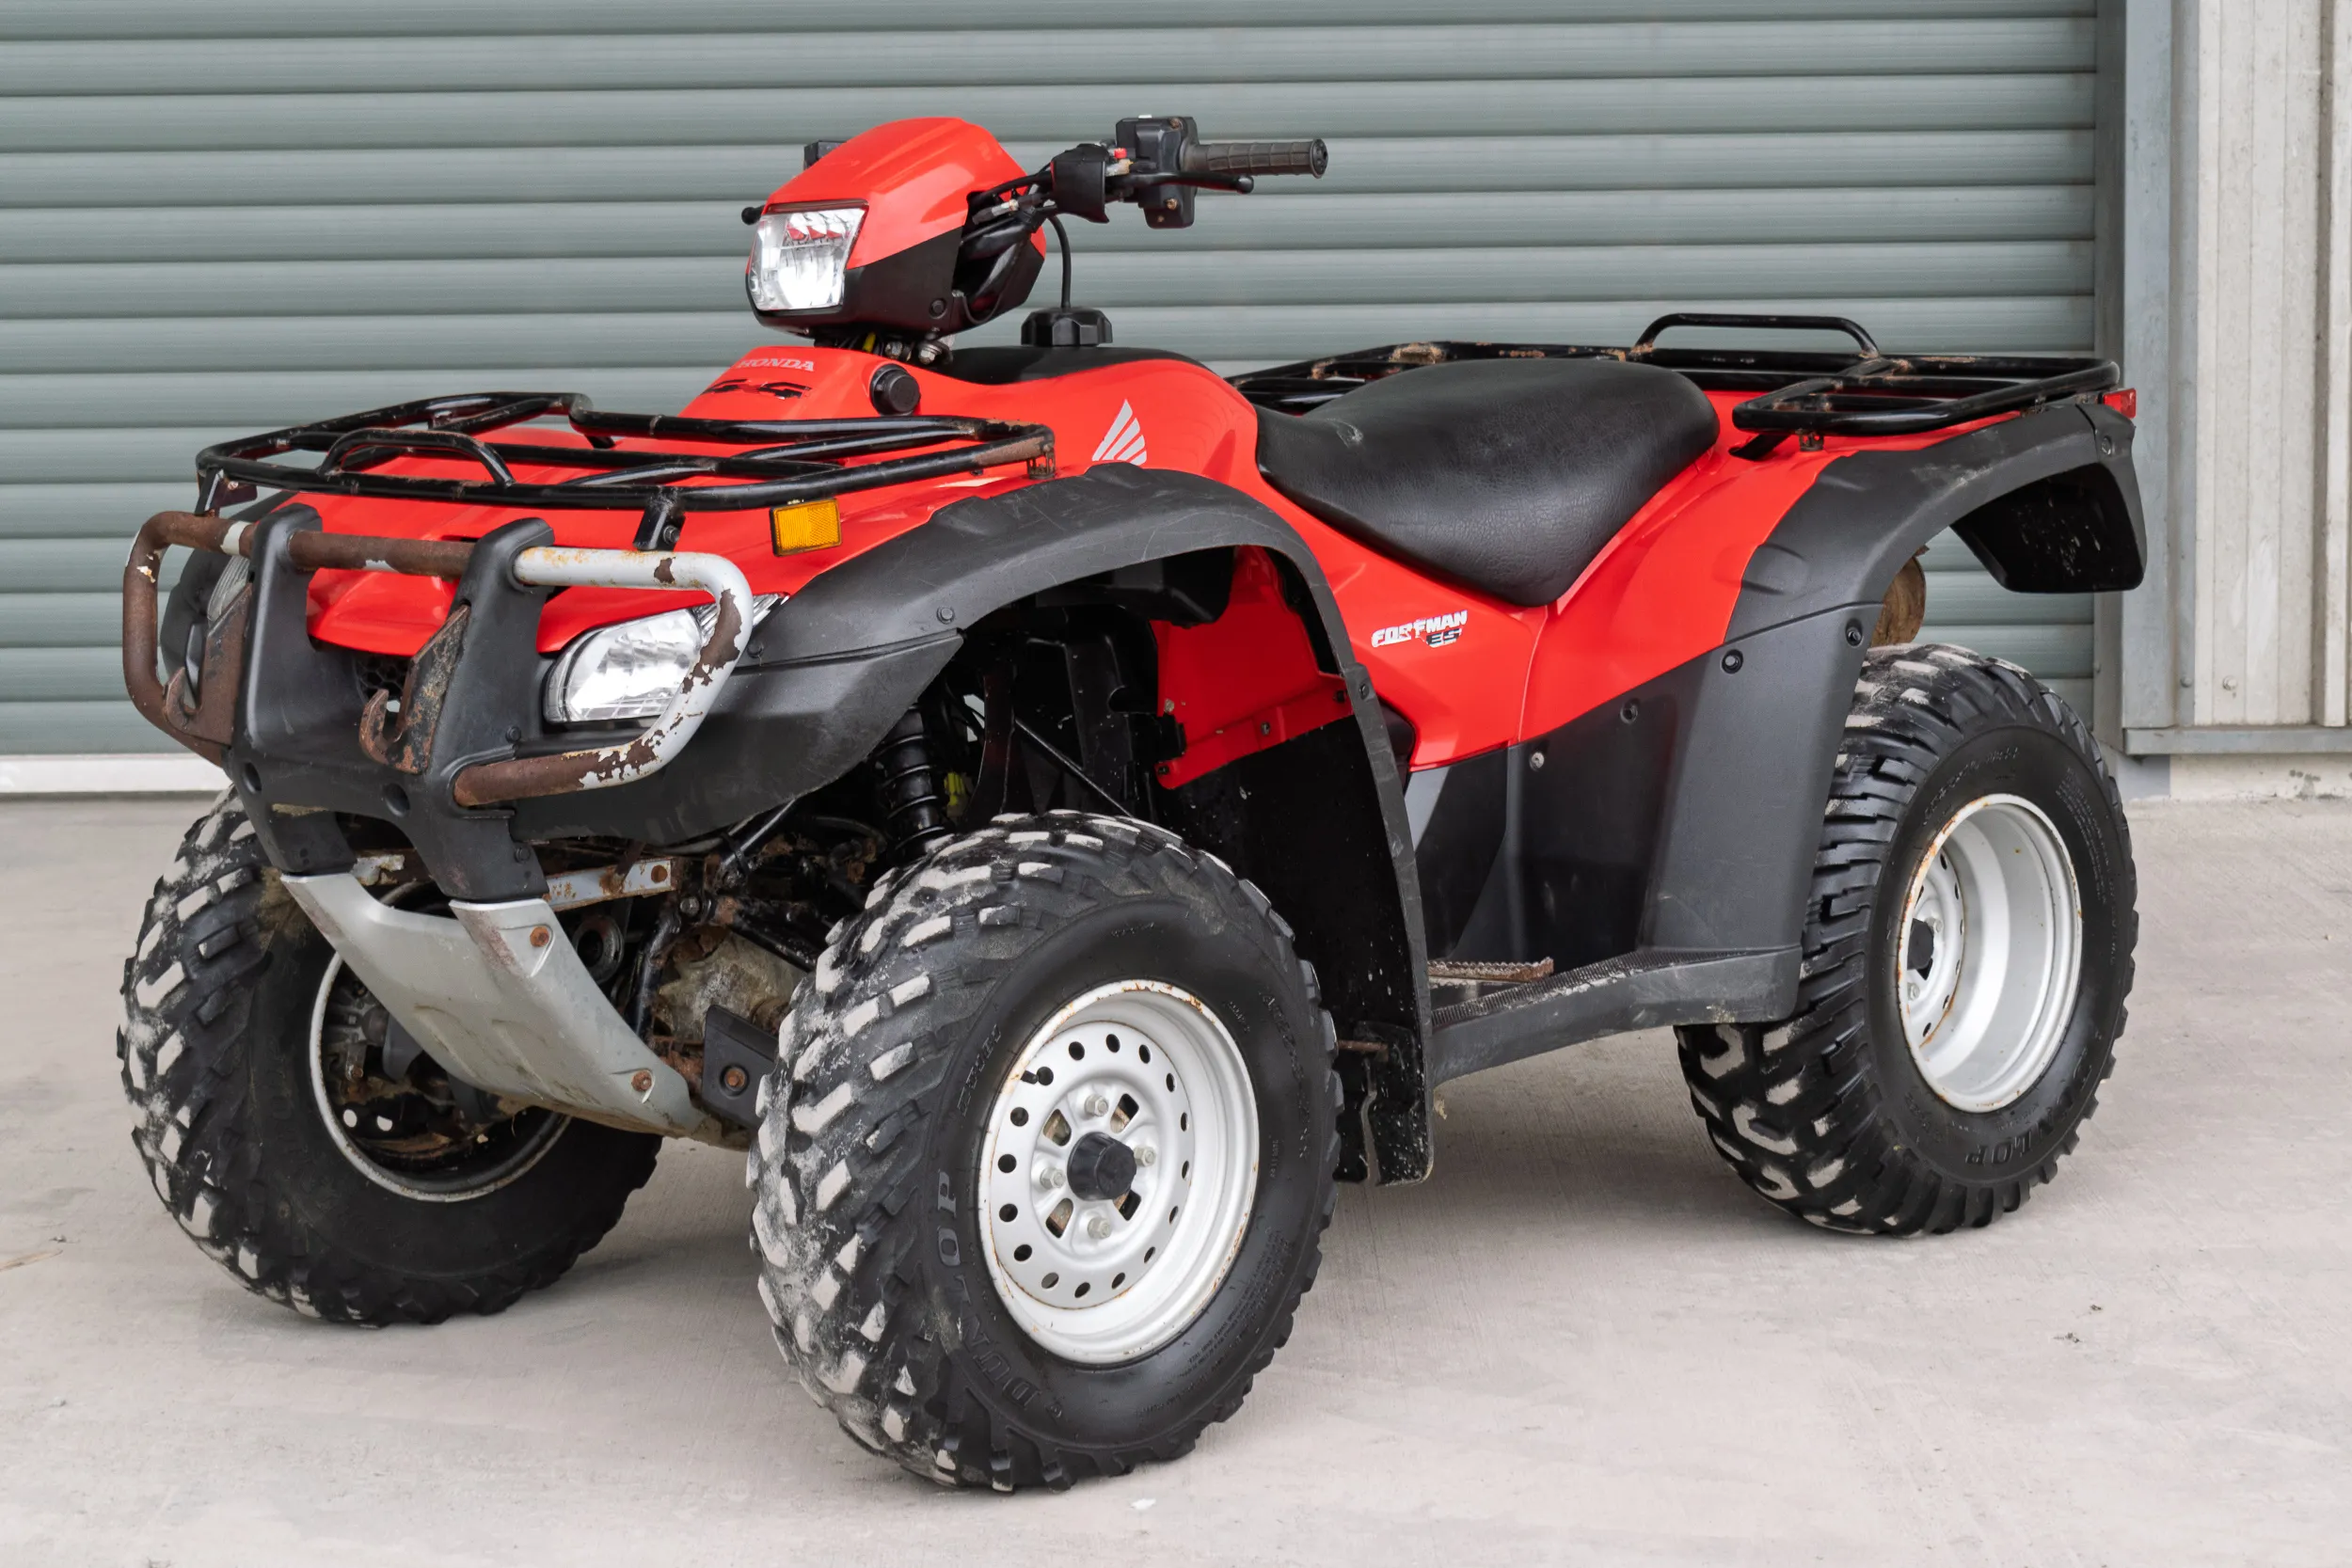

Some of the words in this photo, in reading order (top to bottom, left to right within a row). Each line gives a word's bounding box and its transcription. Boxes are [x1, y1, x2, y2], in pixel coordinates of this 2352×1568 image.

[738, 358, 815, 372] HONDA
[1425, 628, 1462, 647] ES
[937, 1171, 1041, 1408] DUNLOP
